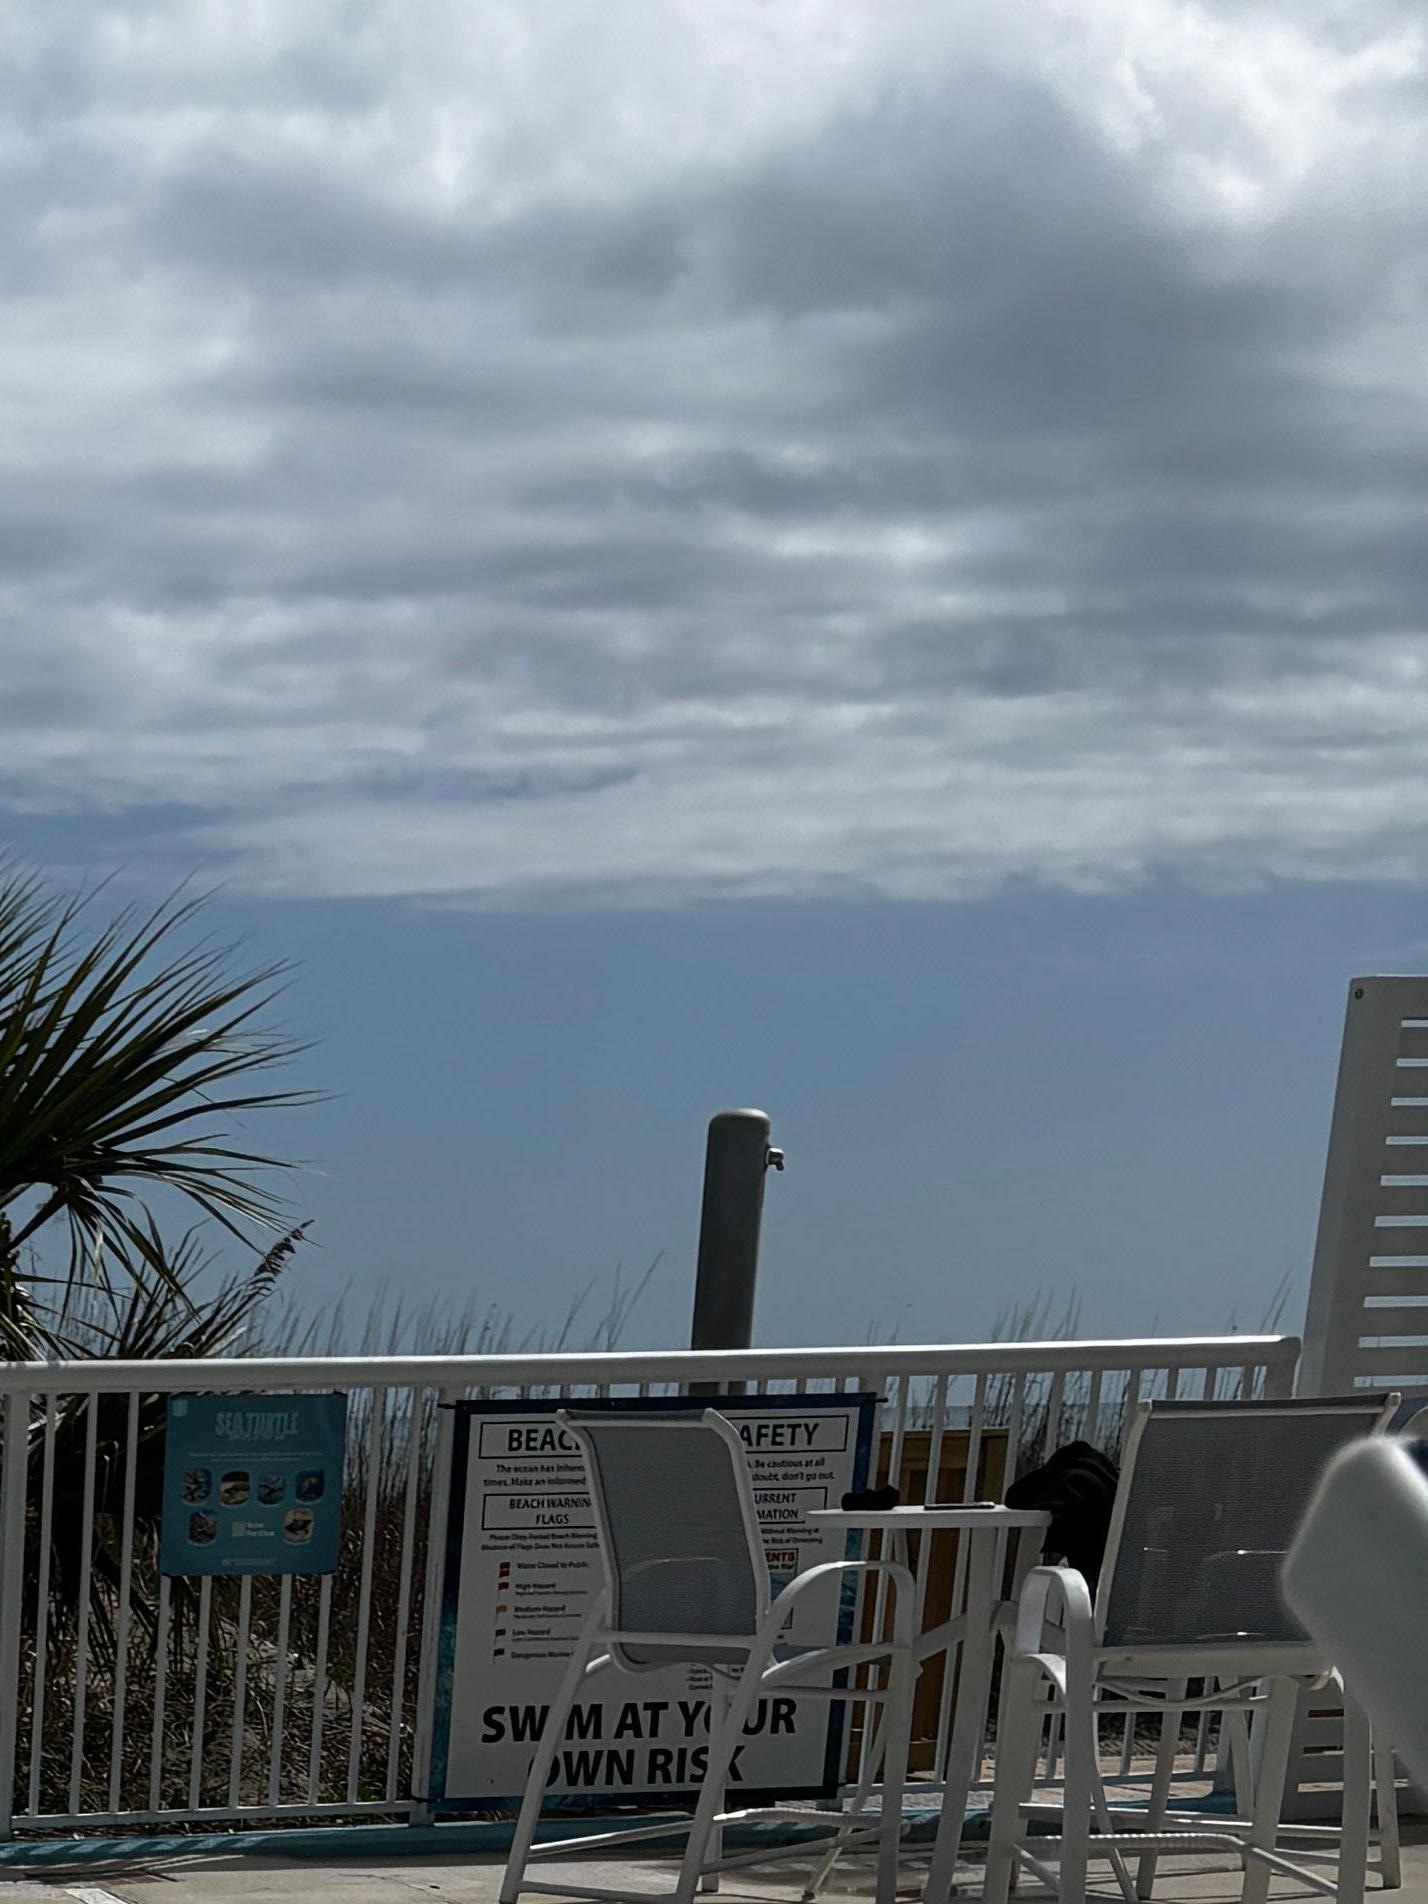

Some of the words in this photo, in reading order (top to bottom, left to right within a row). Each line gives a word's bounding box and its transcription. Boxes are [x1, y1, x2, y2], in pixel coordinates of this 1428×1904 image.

[507, 1428, 581, 1452] BEAC
[740, 1423, 820, 1447] AFETY
[509, 1498, 545, 1510] BEACH
[546, 1497, 593, 1509] WARNIN
[754, 1493, 797, 1504] URRENT
[535, 1514, 569, 1525] FLAGS
[481, 1703, 603, 1743] SWM
[613, 1701, 669, 1739] AT
[677, 1698, 797, 1738] YUR
